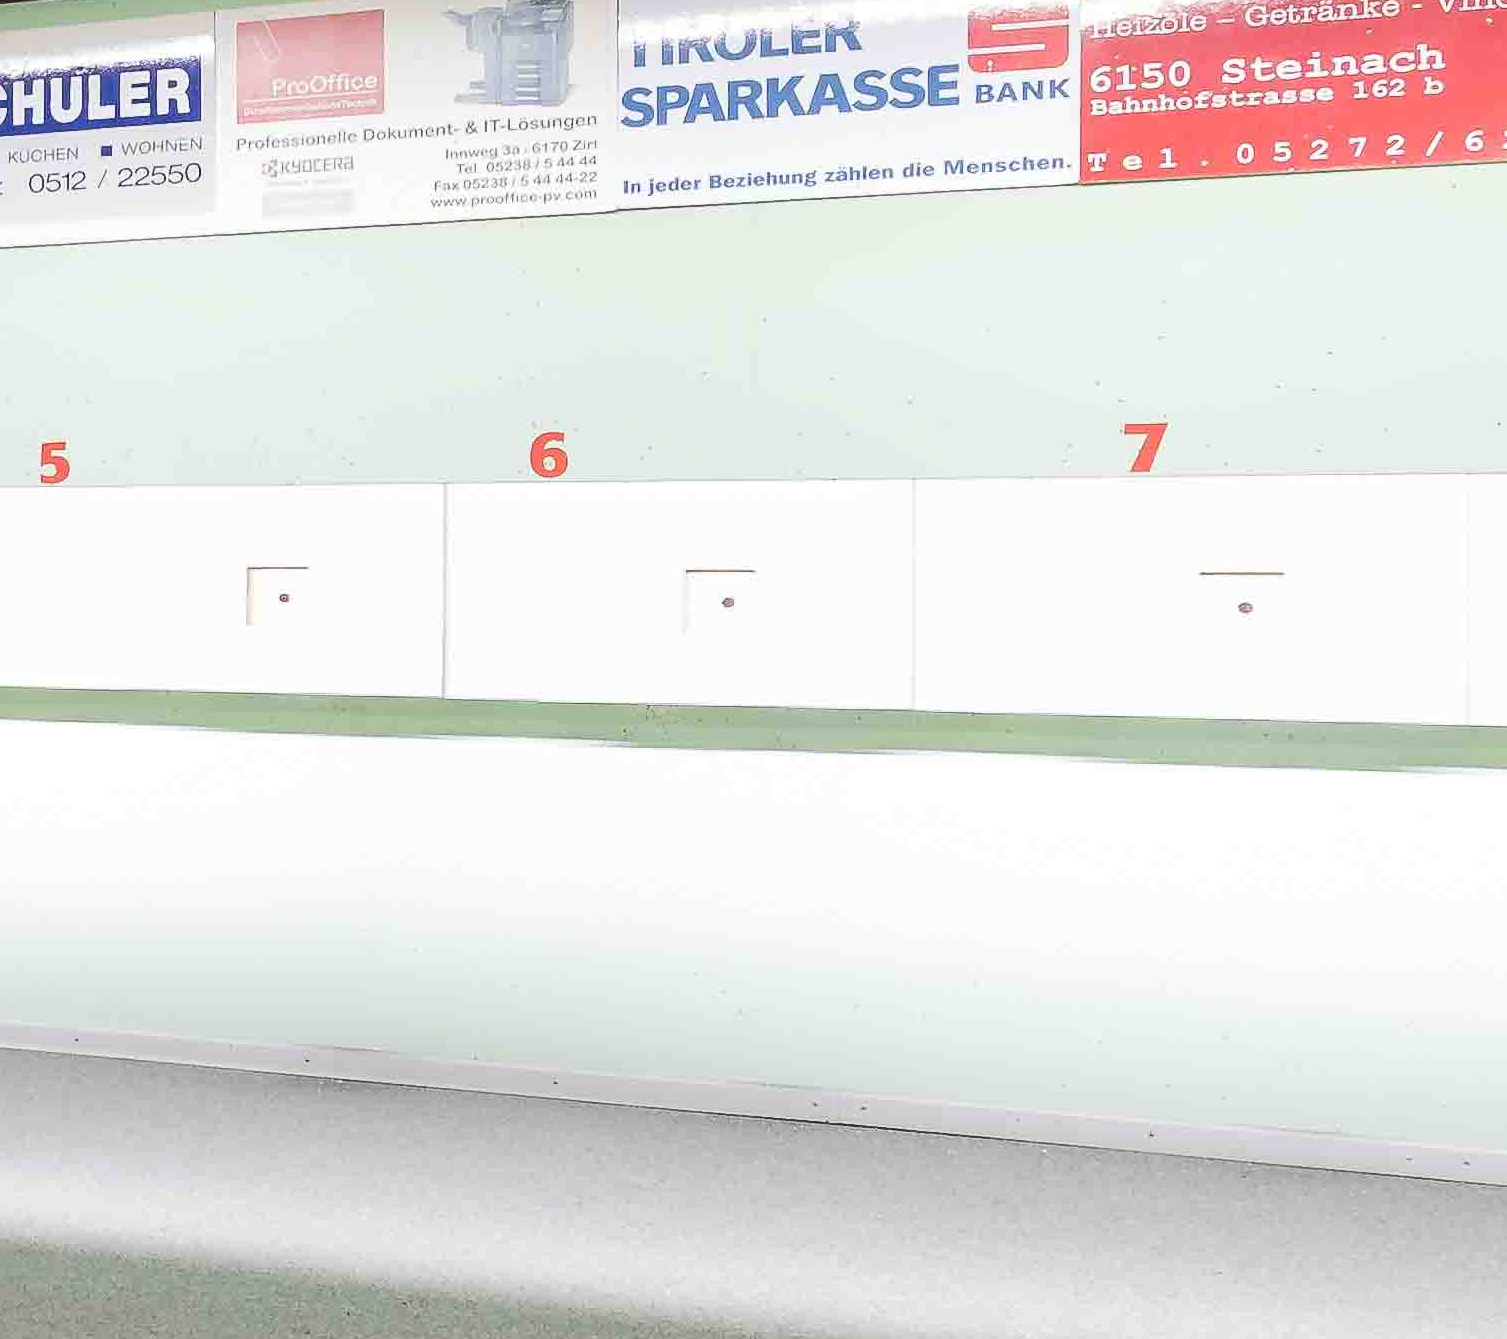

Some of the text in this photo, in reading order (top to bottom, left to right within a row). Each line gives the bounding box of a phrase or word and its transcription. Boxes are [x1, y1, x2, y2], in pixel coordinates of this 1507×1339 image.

[272, 71, 378, 96] ProOffice
[1089, 42, 1446, 93] 6150 Steinach
[621, 64, 1070, 128] SPARKASSE BANK
[1089, 76, 1445, 117] Bahnhofstrasse 162 b
[121, 137, 203, 156] WOHNEN
[237, 116, 598, 150] Professionelle Dokument- & IT-Lösungen
[445, 147, 498, 160] Innweg
[532, 142, 568, 154] 6170
[572, 140, 598, 151] Zirl
[29, 171, 87, 193] 0512
[95, 169, 107, 189] /
[117, 163, 202, 187] 22550
[434, 181, 460, 193] Fax
[464, 176, 508, 190] 05238
[533, 174, 551, 185] 44
[556, 171, 598, 184] 44-22
[486, 160, 531, 173] 05238
[544, 158, 552, 168] 5
[556, 157, 575, 168] 44
[579, 155, 597, 166] 44
[622, 154, 1072, 196] In jeder Beziehung zählen die Menschen.
[41, 442, 70, 484] 5
[531, 432, 567, 477] 6
[1125, 424, 1166, 472] 7
